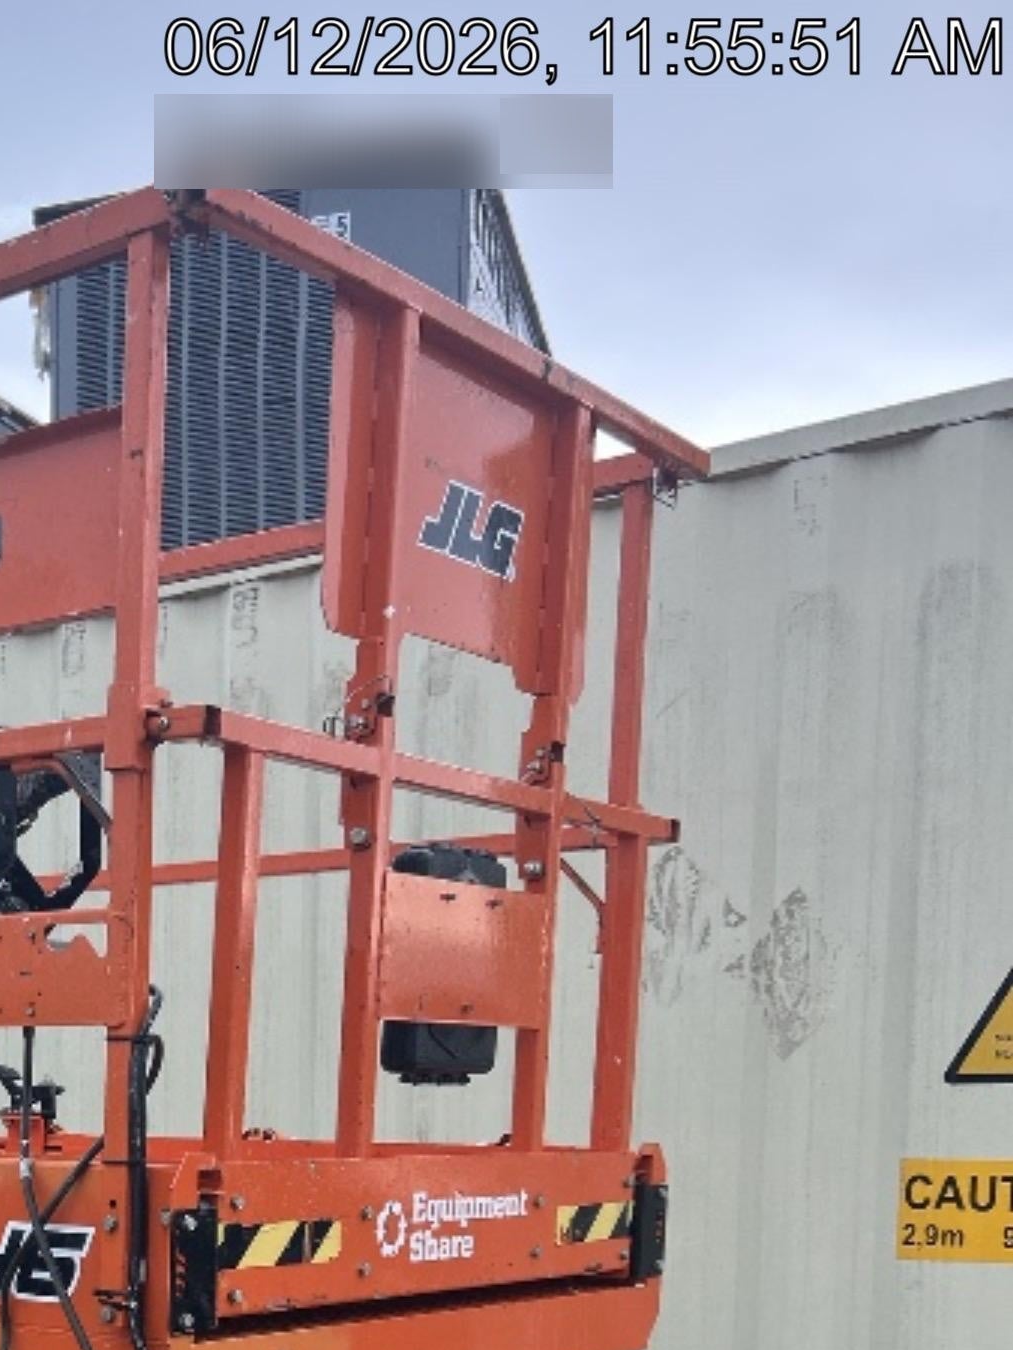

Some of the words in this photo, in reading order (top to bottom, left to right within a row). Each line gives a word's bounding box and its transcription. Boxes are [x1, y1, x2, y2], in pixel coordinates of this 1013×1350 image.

[417, 480, 525, 582] JLG
[412, 1188, 528, 1228] Equipment
[409, 1230, 474, 1262] Share
